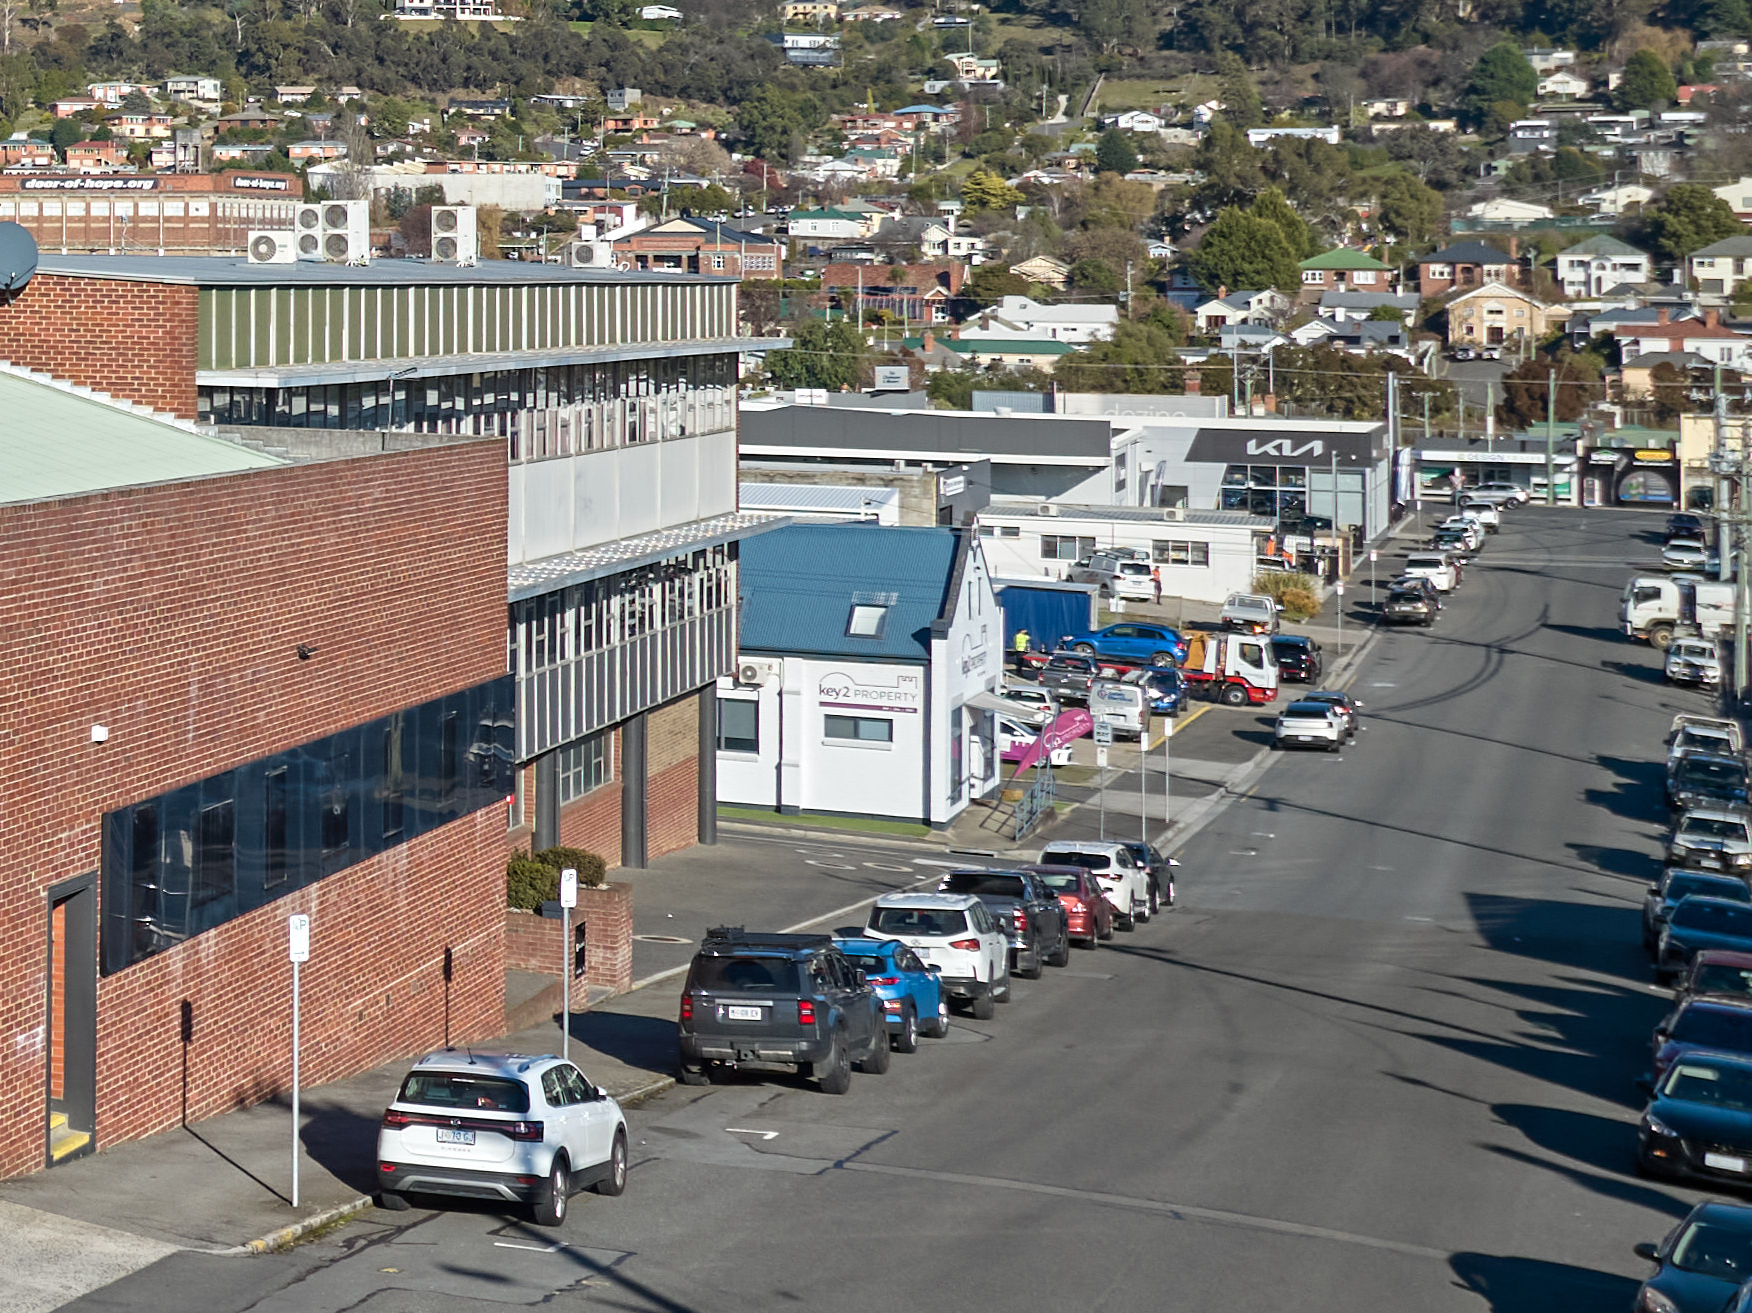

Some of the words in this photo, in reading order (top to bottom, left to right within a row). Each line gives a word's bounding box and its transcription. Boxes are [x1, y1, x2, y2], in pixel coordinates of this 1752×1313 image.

[25, 178, 154, 190] door-of-hope.org
[1246, 438, 1323, 457] KIA
[819, 683, 850, 700] key2
[854, 689, 918, 702] PROPERTY
